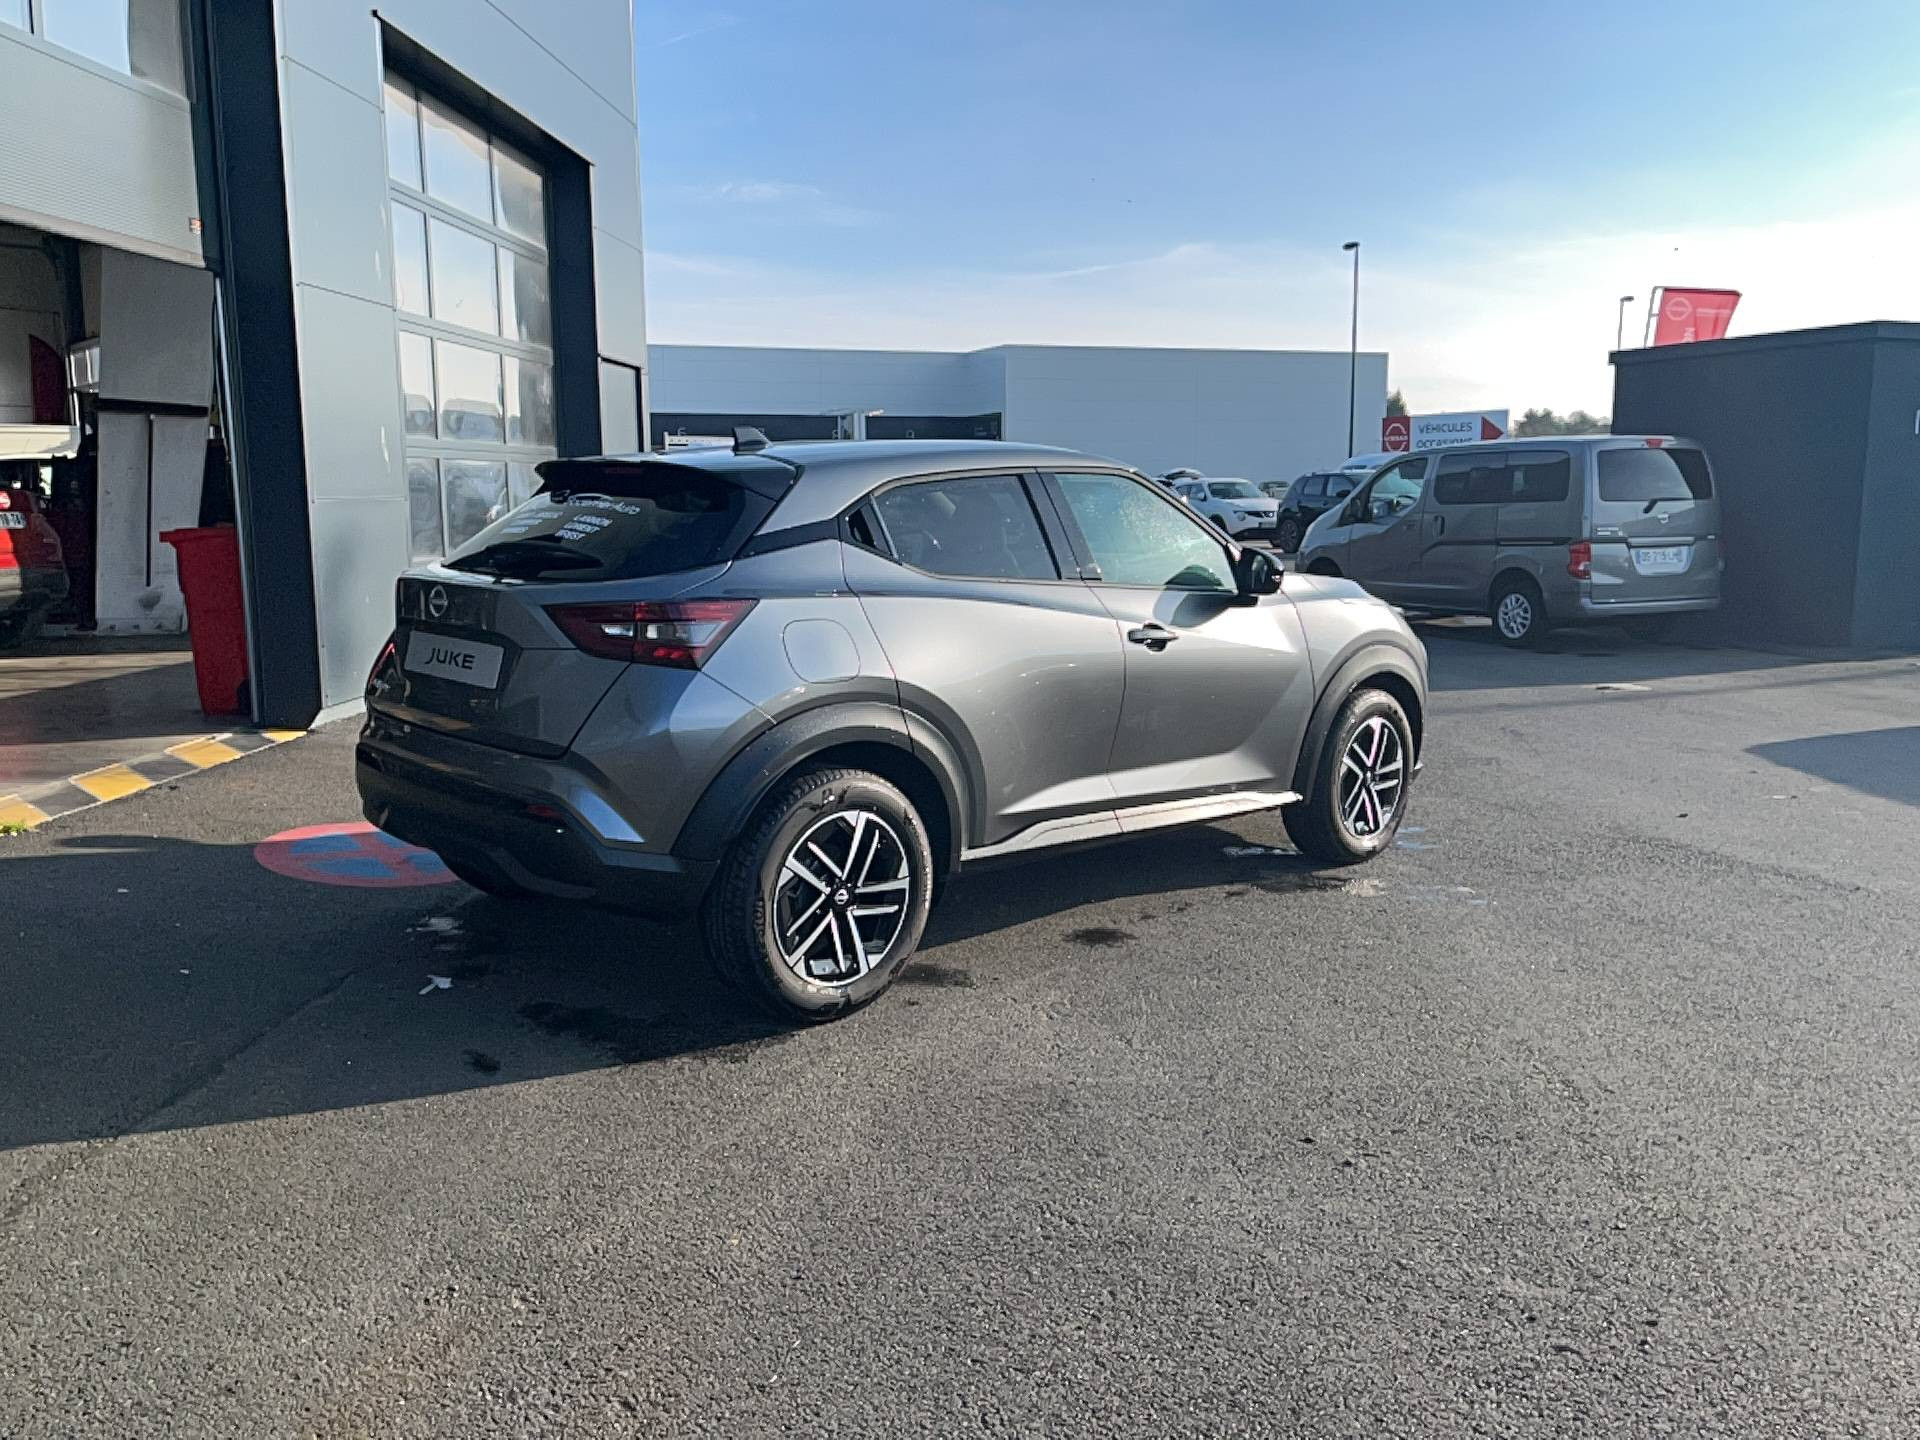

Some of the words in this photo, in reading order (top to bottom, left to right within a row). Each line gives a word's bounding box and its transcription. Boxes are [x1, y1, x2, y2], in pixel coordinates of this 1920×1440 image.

[1417, 422, 1473, 434] VÉHICULES
[1415, 437, 1473, 448] OCCASION
[424, 647, 476, 670] JUKE
